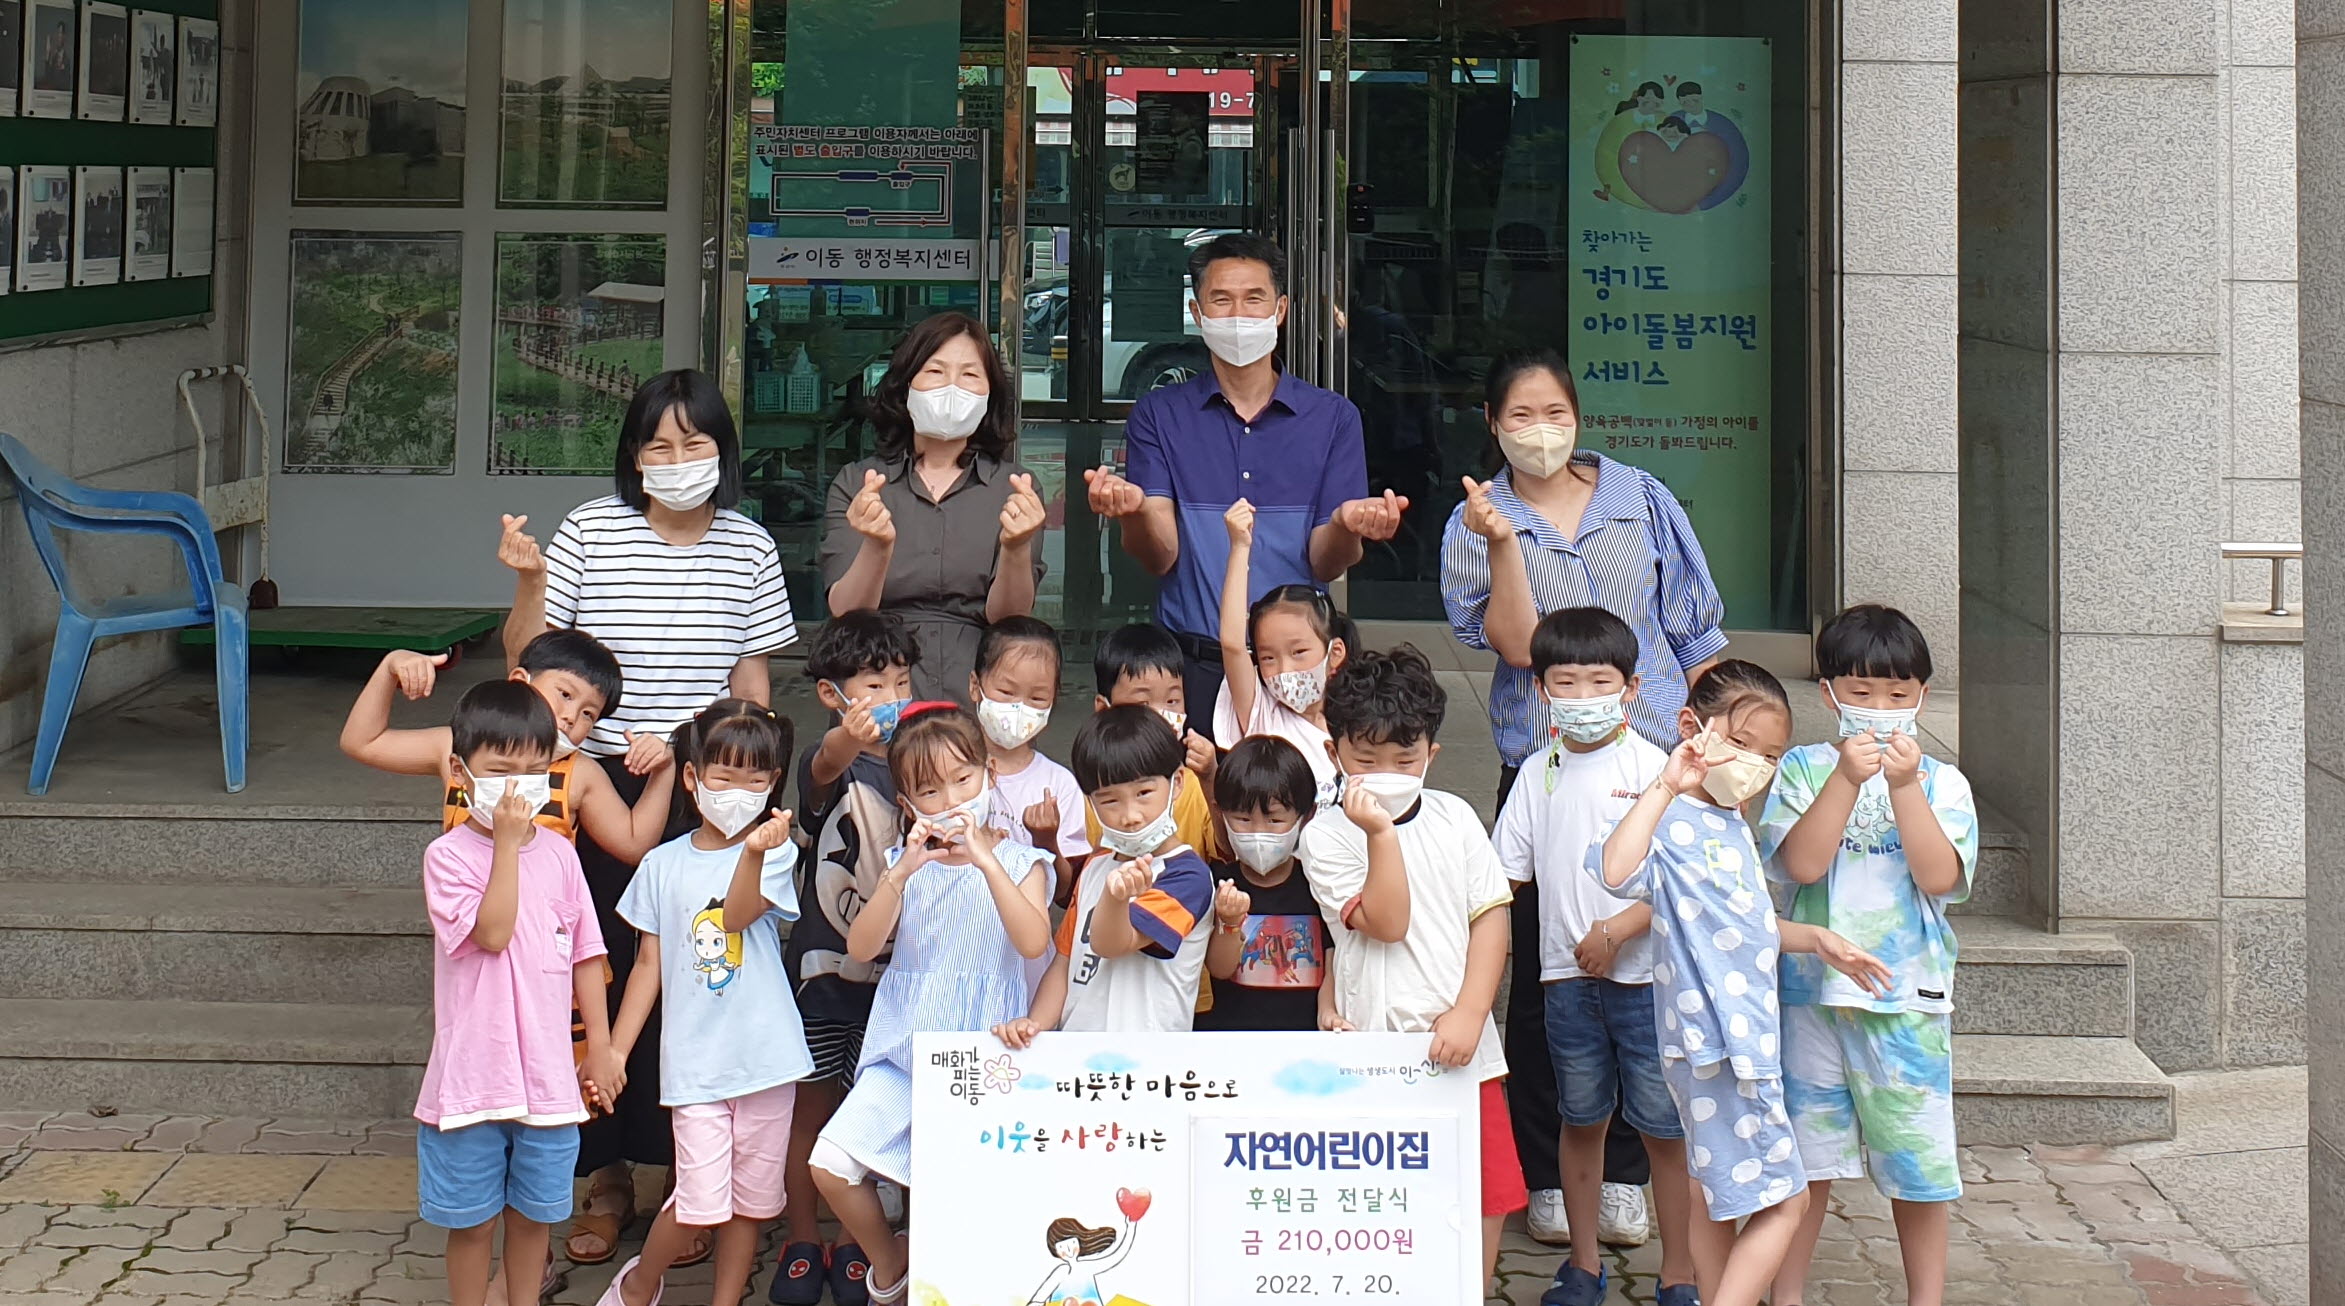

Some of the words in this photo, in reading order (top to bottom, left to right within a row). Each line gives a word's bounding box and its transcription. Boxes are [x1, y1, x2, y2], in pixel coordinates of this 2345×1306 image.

[754, 127, 821, 140] 주민자치센터
[824, 127, 869, 140] 프로그램
[874, 127, 941, 141] 이용자께서는
[944, 128, 978, 141] 아래에
[755, 145, 789, 156] 표시된
[793, 145, 816, 157] 별도
[820, 145, 864, 157] 출입구를
[869, 146, 925, 158] 이용하시기
[929, 147, 977, 159] 바랍니다.
[1582, 229, 1653, 252] 찾아가는
[805, 248, 844, 269] 이동
[854, 247, 971, 270] 행정복지센터
[1582, 265, 1669, 300] 경기도
[1583, 313, 1758, 350] 아이돌봄지원
[1583, 360, 1670, 386] 서비스
[1681, 416, 1718, 430] 가정의
[1722, 416, 1759, 430] 아이를
[1605, 435, 1655, 449] 경기도가
[1659, 436, 1737, 450] 돌봐드립니다.
[931, 1046, 980, 1067] 매화가
[953, 1065, 981, 1081] 피는
[950, 1083, 986, 1106] 이동
[1056, 1072, 1136, 1101] 따뜻한
[1146, 1070, 1239, 1101] 마음으로
[980, 1121, 1050, 1153] 이웃을
[1061, 1121, 1167, 1152] 사랑하는
[1224, 1130, 1430, 1170] 자연어린이집
[1246, 1187, 1318, 1213] 후원금
[1337, 1187, 1409, 1213] 전달식
[1241, 1230, 1264, 1255] 금
[1278, 1228, 1414, 1256] 210,000원
[1256, 1275, 1319, 1295] 2022.
[1332, 1275, 1351, 1295] 7.
[1364, 1275, 1400, 1295] 20.
